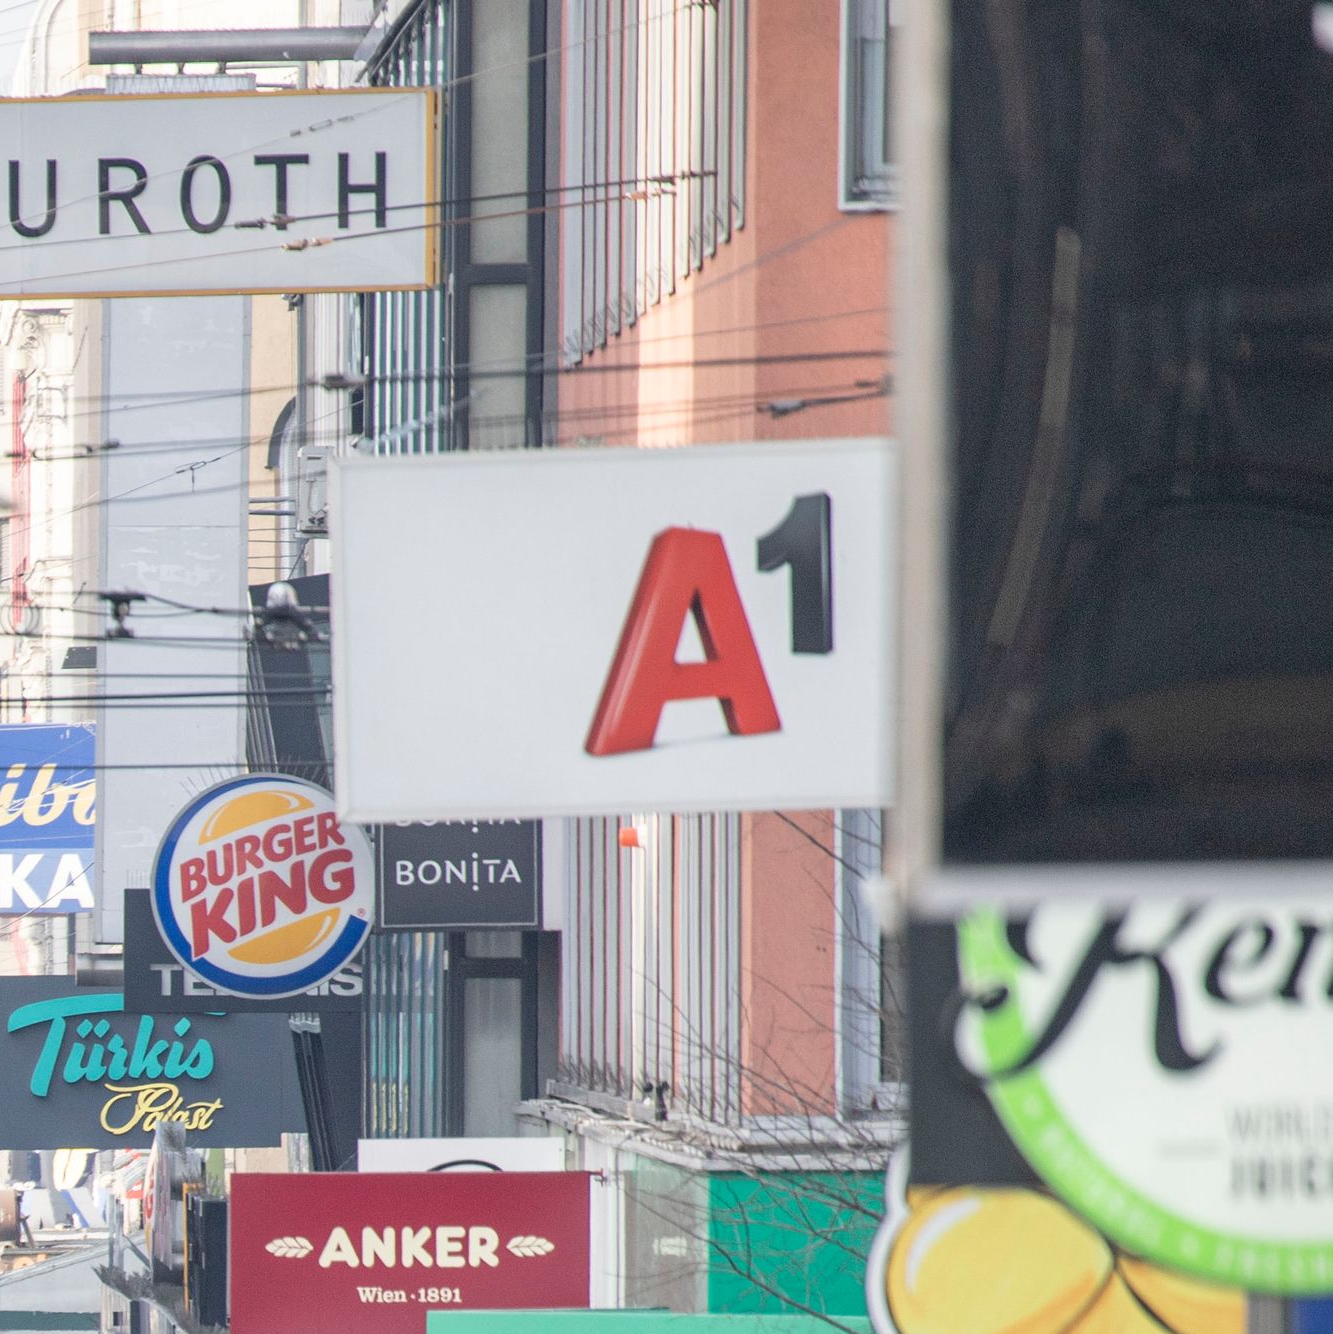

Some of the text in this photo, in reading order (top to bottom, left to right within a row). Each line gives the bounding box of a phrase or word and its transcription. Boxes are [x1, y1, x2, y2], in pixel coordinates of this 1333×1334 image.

[584, 487, 834, 757] A1
[179, 811, 356, 959] BURGER KING
[150, 962, 363, 997] TEIS
[7, 993, 215, 1097] Türkis
[318, 1226, 500, 1268] ANKER
[357, 1286, 462, 1303] Wien 1891
